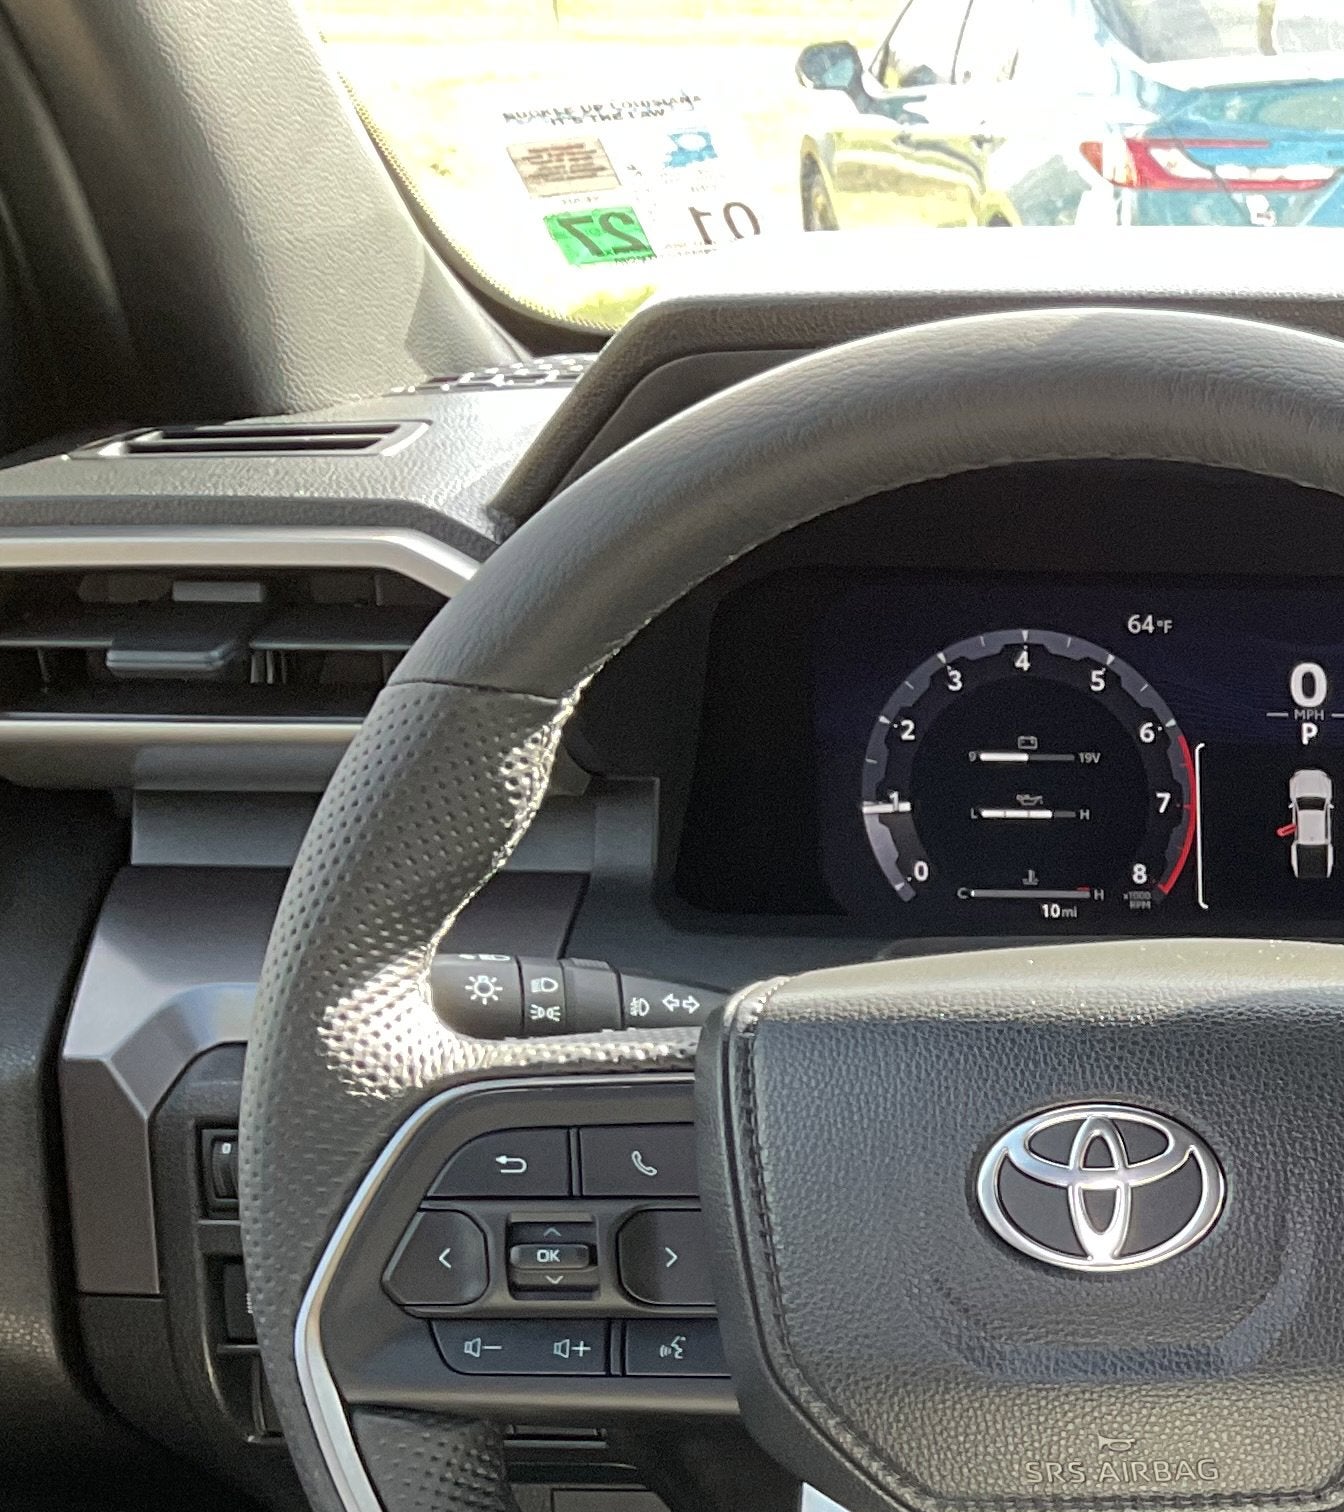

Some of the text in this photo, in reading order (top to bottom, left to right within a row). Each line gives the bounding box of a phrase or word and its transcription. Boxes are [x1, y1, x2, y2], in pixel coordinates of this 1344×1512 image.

[1015, 651, 1030, 671] 4
[948, 670, 963, 691] 3
[1090, 671, 1105, 691] 5
[1290, 663, 1328, 707] 0
[1294, 709, 1324, 721] MPH
[901, 720, 915, 741] 2
[1140, 722, 1155, 743] 6
[1301, 723, 1318, 744] P
[1079, 752, 1101, 764] 19V
[1156, 792, 1171, 813] 7
[971, 808, 978, 819] L
[1080, 809, 1090, 820] H
[913, 861, 929, 881] 0
[1132, 864, 1147, 884] 8
[1094, 888, 1104, 900] H
[1129, 900, 1151, 910] RPM
[536, 1249, 560, 1262] OK
[1025, 1458, 1221, 1484] SRS AIRBAG
